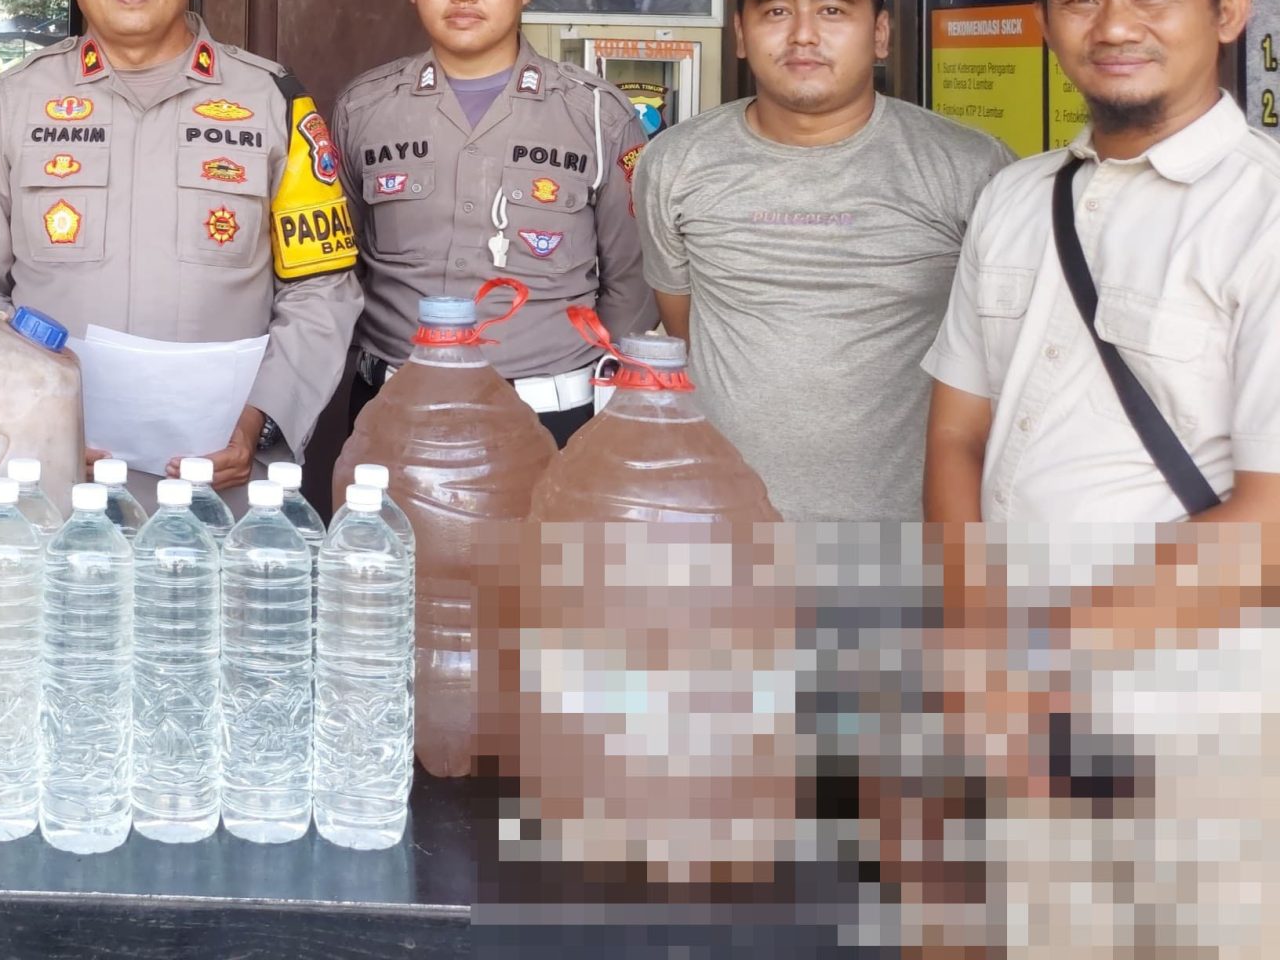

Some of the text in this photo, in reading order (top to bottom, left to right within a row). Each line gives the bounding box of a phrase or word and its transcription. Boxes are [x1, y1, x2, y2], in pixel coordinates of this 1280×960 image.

[947, 18, 1023, 37] REKOMENDASI SKCK
[1261, 34, 1279, 72] 1.
[620, 82, 664, 92] JAWA TIMUR
[1261, 90, 1279, 127] 2.
[30, 127, 106, 143] CHAKIM
[185, 127, 263, 148] POLRI
[364, 140, 429, 166] BAYU
[511, 145, 589, 174] POLRI
